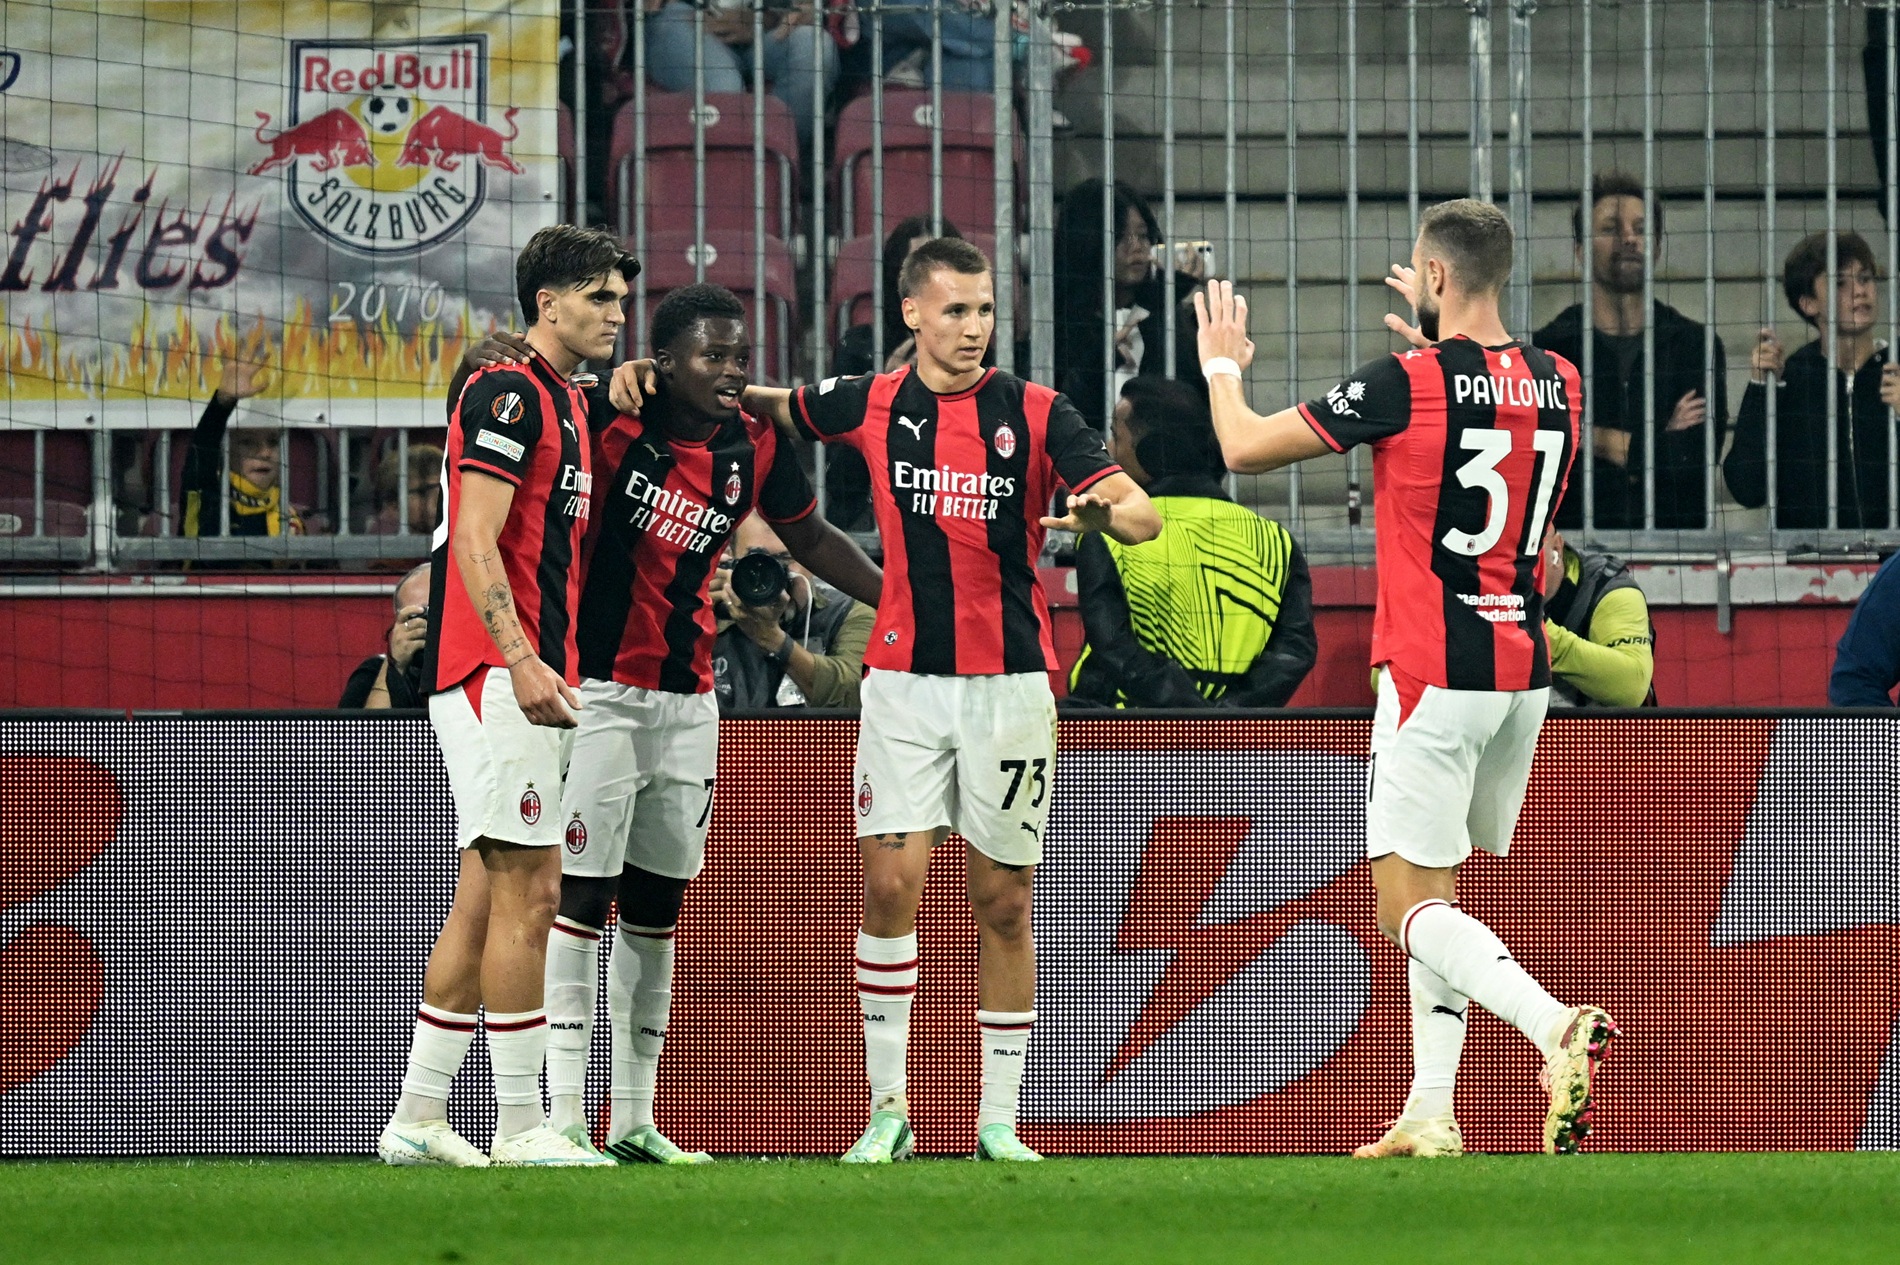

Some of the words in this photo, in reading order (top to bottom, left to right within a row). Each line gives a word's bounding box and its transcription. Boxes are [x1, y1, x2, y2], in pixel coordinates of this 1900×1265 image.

[303, 53, 385, 92] Red
[394, 49, 472, 91] Bull
[307, 176, 466, 240] SALZBURG
[329, 280, 445, 322] 2010
[894, 461, 1015, 497] Emirates
[1441, 428, 1565, 556] 31
[625, 470, 735, 534] Emirates
[912, 493, 938, 515] FLY
[942, 496, 998, 519] BETTER
[629, 506, 661, 532] FLY
[656, 518, 712, 553] BETTER
[1000, 758, 1047, 810] 73
[550, 1022, 584, 1030] MILAN
[640, 1026, 667, 1037] MILA
